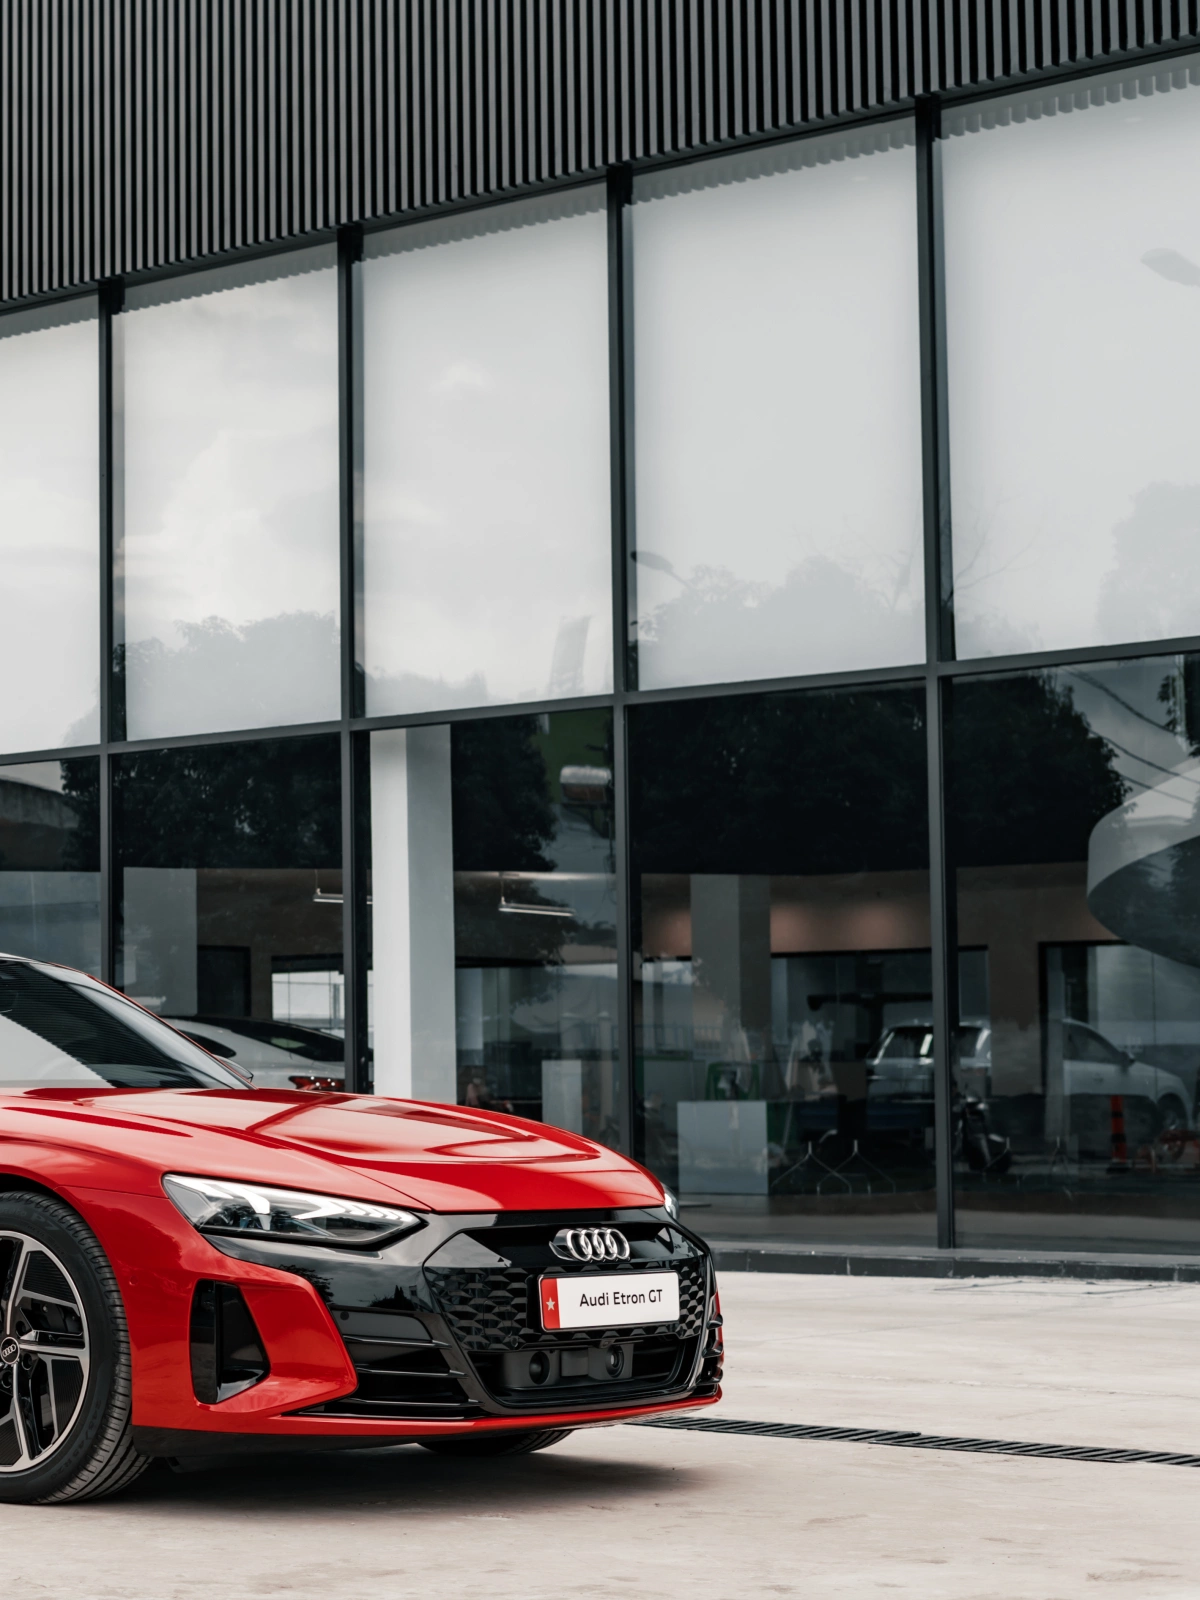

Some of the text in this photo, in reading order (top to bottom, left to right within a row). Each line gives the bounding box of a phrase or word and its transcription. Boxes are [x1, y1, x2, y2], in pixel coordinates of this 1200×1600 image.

[579, 1289, 662, 1307] Audi Etron GT
